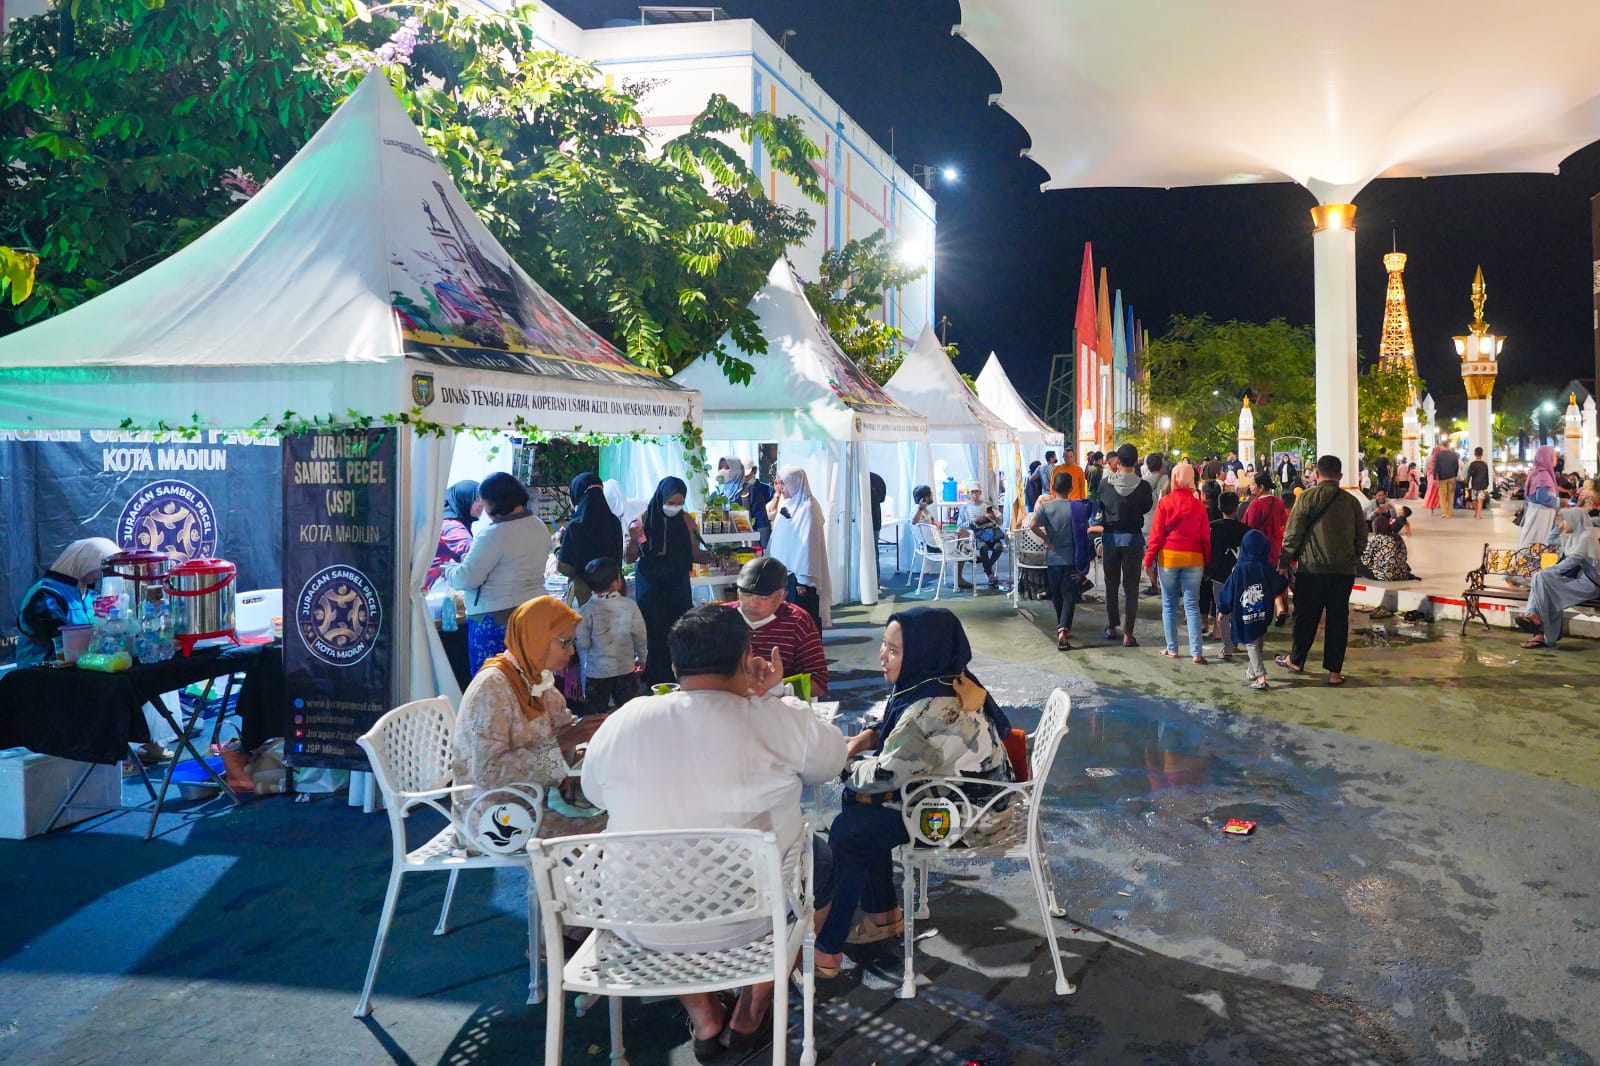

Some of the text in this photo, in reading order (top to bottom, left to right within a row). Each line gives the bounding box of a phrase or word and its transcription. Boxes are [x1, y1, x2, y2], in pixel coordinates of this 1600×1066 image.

[441, 387, 470, 405] DINAS
[471, 389, 504, 408] TENAGA
[505, 392, 530, 411] KERJA,
[532, 395, 567, 412] KOPERASI
[568, 398, 590, 413] USAHA
[591, 400, 609, 414] KECIL
[610, 401, 622, 414] DAN
[622, 402, 651, 416] MENENGAH
[652, 403, 667, 416] KOTA
[310, 435, 368, 459] JURAGAN
[103, 448, 226, 471] KOTA MADIUN
[295, 460, 386, 484] SAMBEL PECEL
[124, 486, 212, 541] JURAGAN SAMBEL PECEL
[325, 489, 355, 517] (JSP)
[300, 524, 380, 543] KOTA MADIUN
[302, 570, 377, 617] JURAGAN SAMBEL PECEL
[315, 640, 365, 658] KOTA MADIUN
[305, 743, 320, 753] JSP
